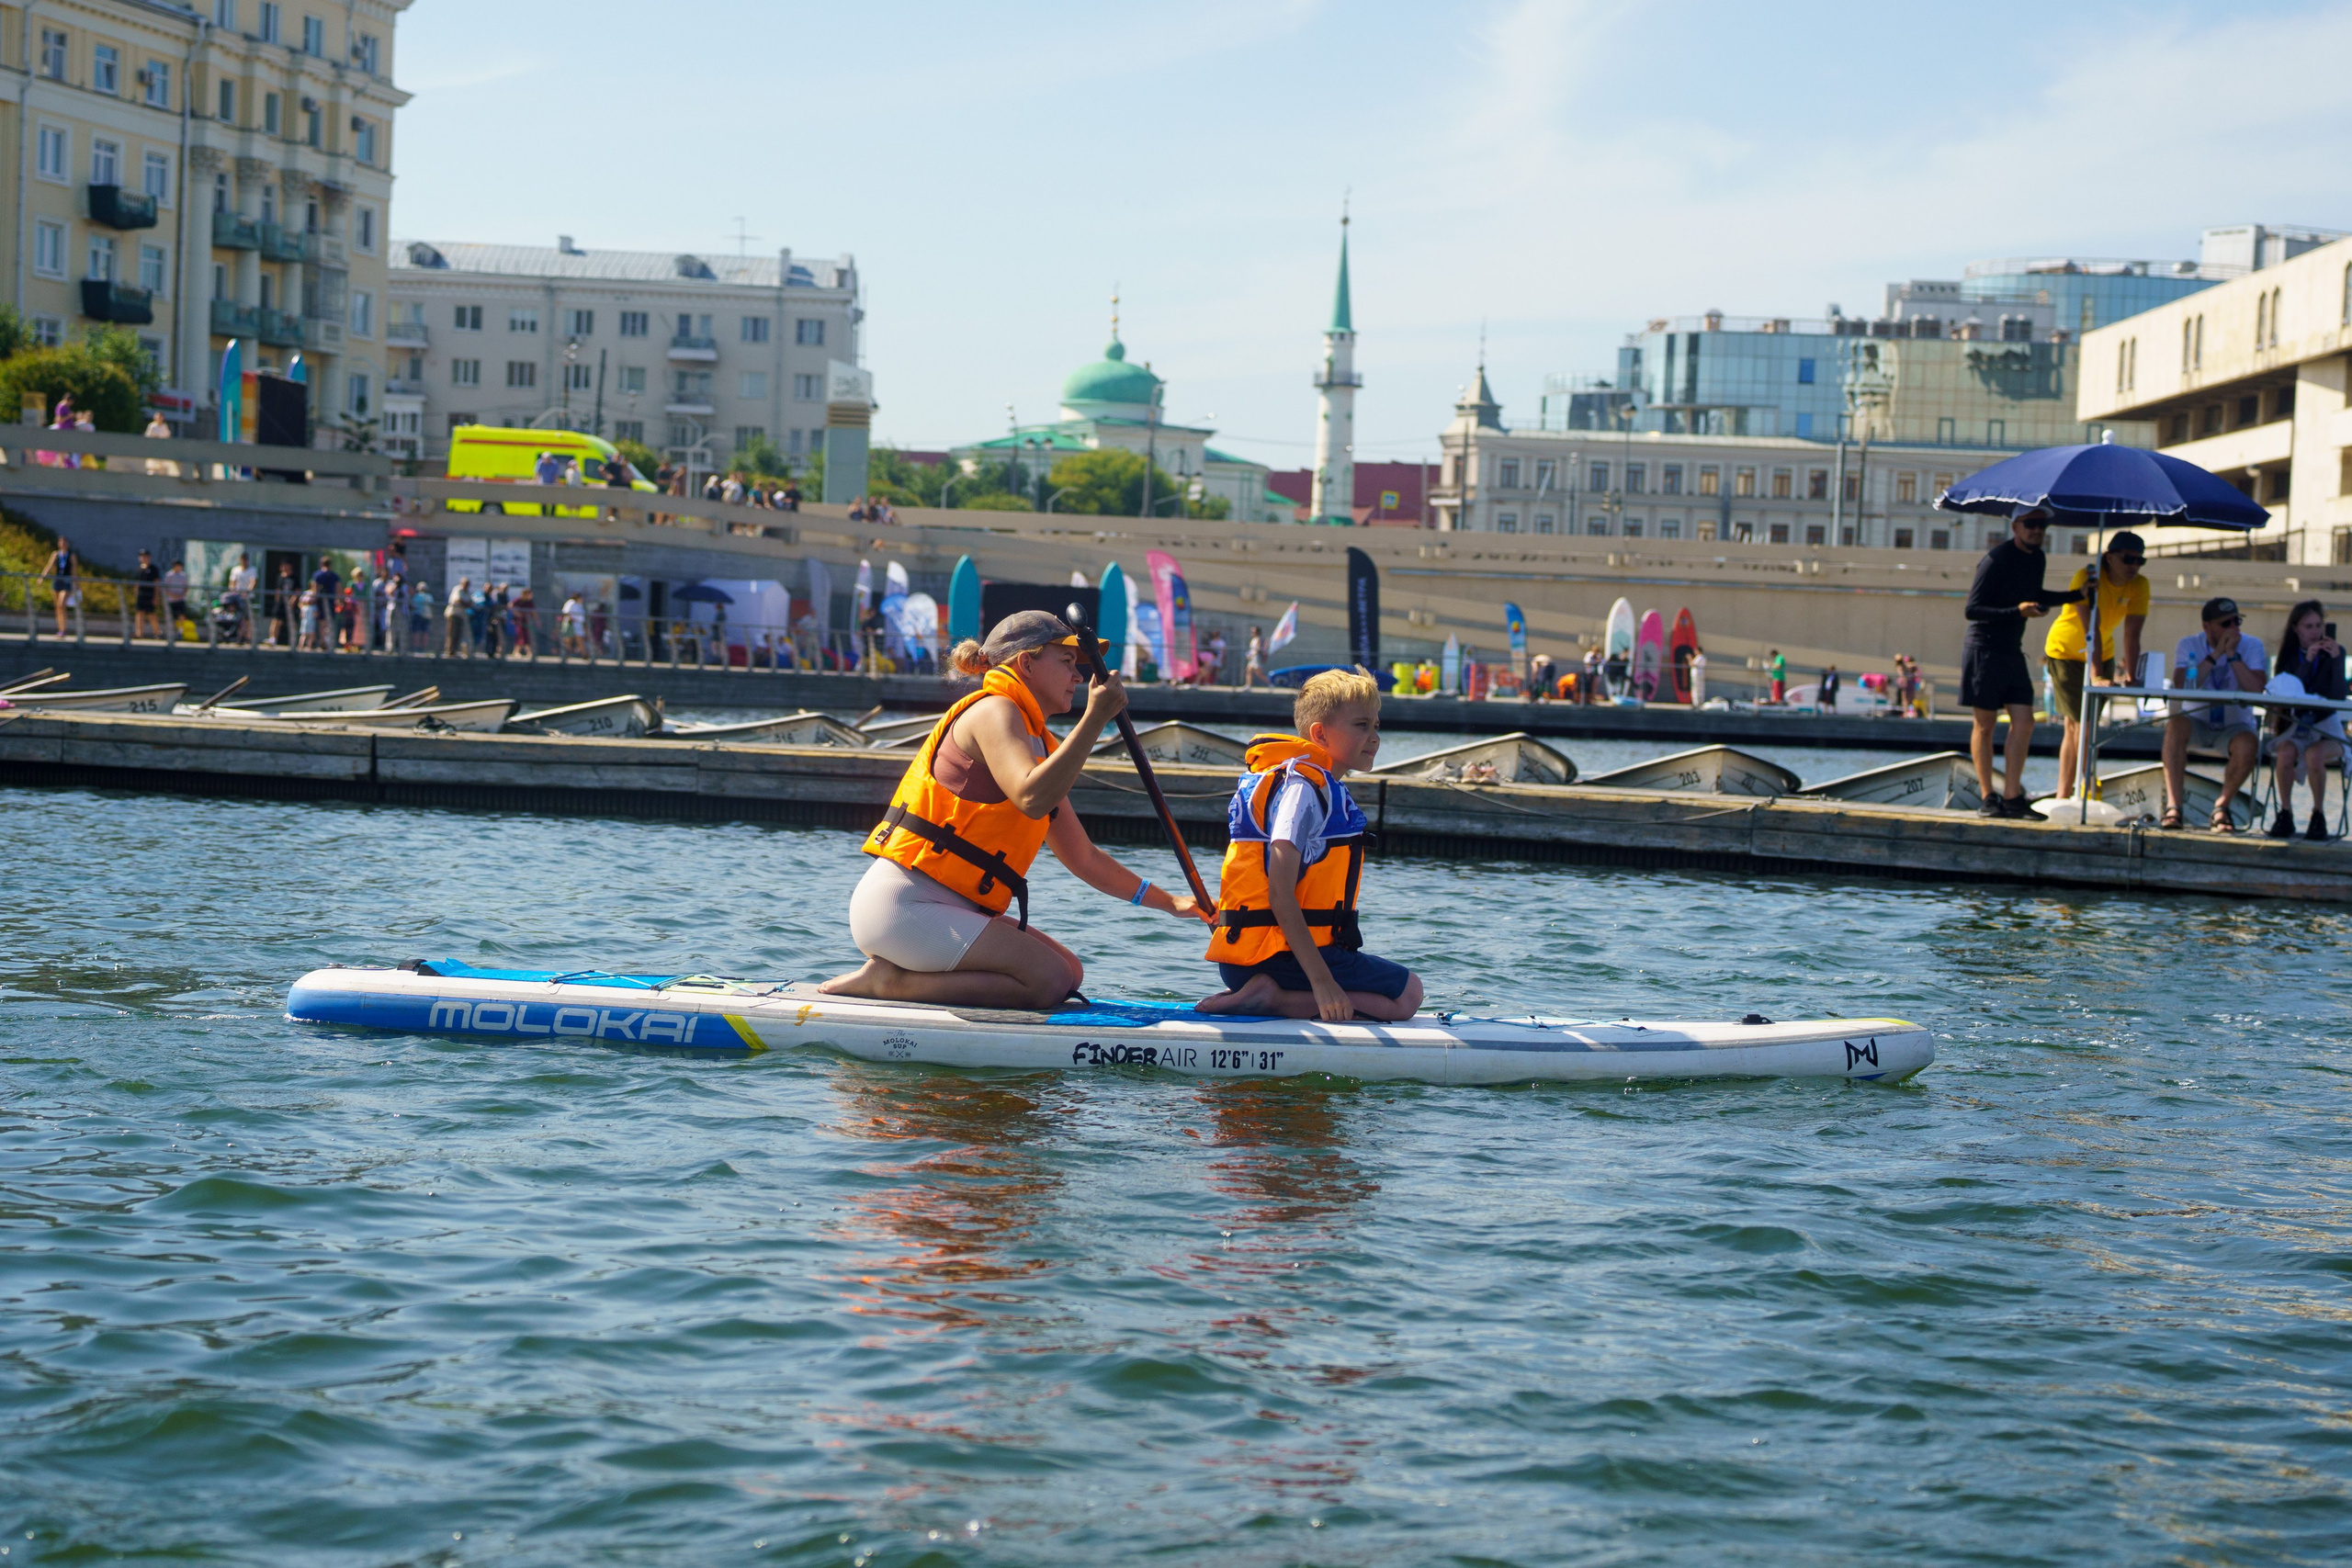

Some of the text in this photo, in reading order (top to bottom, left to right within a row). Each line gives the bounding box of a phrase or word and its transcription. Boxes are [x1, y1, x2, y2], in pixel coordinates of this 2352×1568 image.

[130, 699, 158, 714] 215
[589, 716, 614, 731] 210
[1679, 771, 1702, 786] 203
[1904, 777, 1924, 795] 207
[2125, 788, 2146, 806] 200
[429, 1000, 698, 1043] MOLOKAI
[893, 1029, 906, 1037] The
[882, 1037, 918, 1048] MOLOKAI
[1072, 1042, 1158, 1066] FINDER
[1159, 1047, 1197, 1067] AIR
